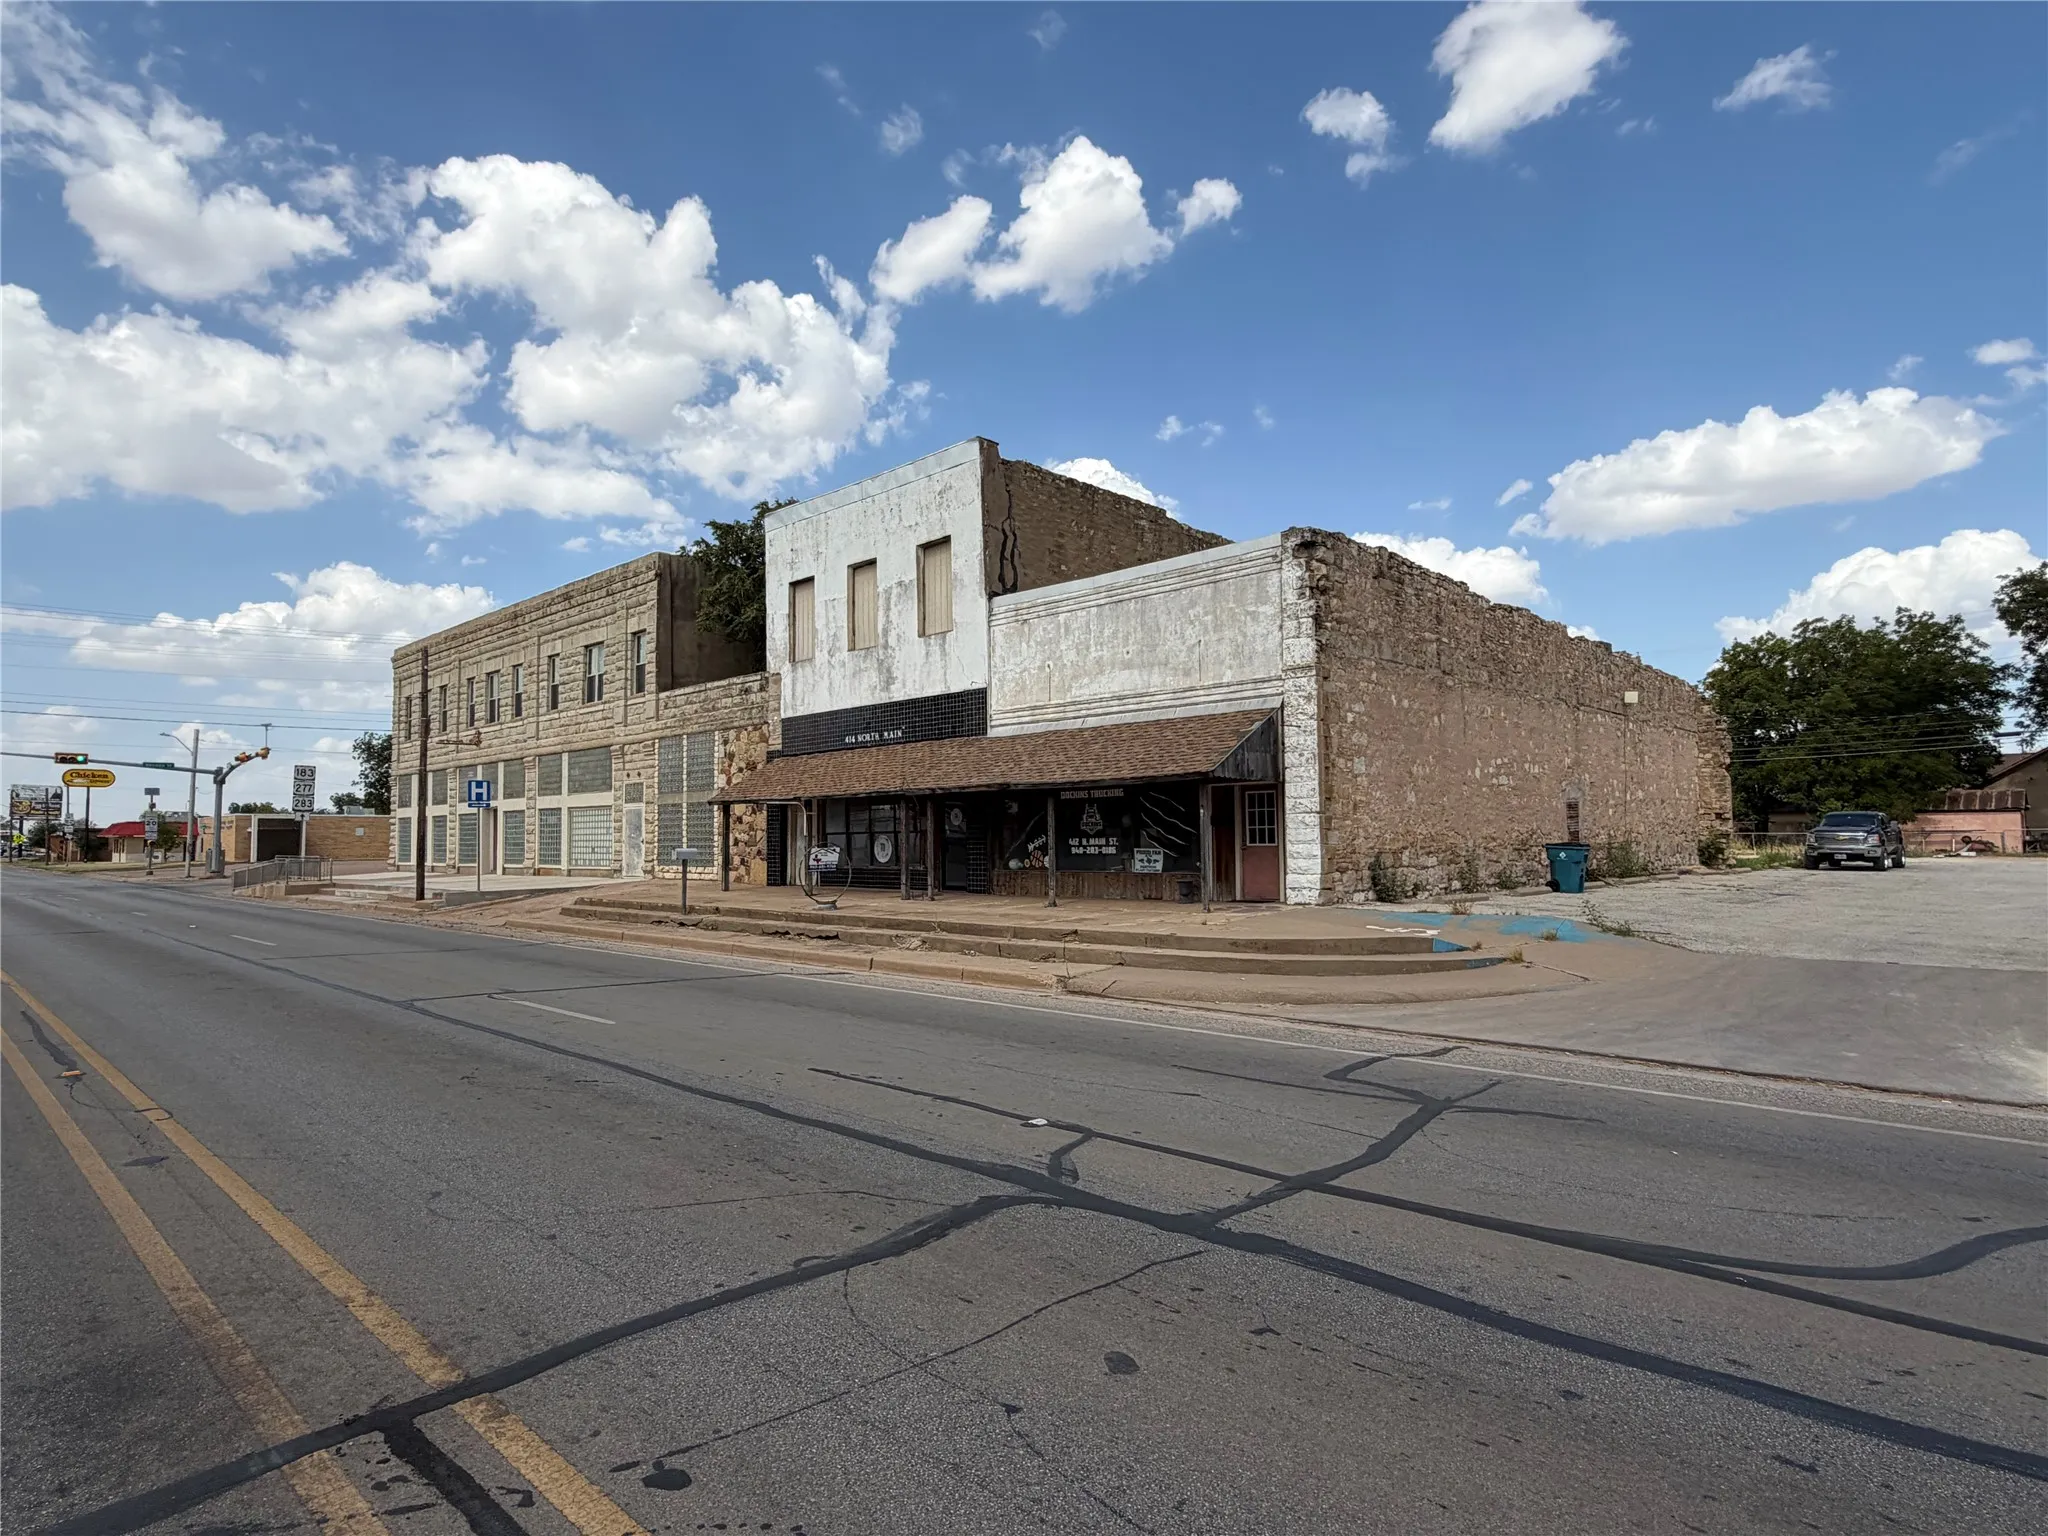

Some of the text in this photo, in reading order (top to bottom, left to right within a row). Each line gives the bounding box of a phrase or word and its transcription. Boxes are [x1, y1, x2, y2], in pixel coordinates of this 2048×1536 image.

[845, 730, 902, 743] 414 NORTH MAIN
[70, 771, 109, 779] Chicken
[296, 768, 314, 777] 183
[295, 783, 313, 793] 277
[471, 781, 488, 801] H
[1090, 788, 1124, 798] TRUCKING
[294, 799, 312, 808] 283
